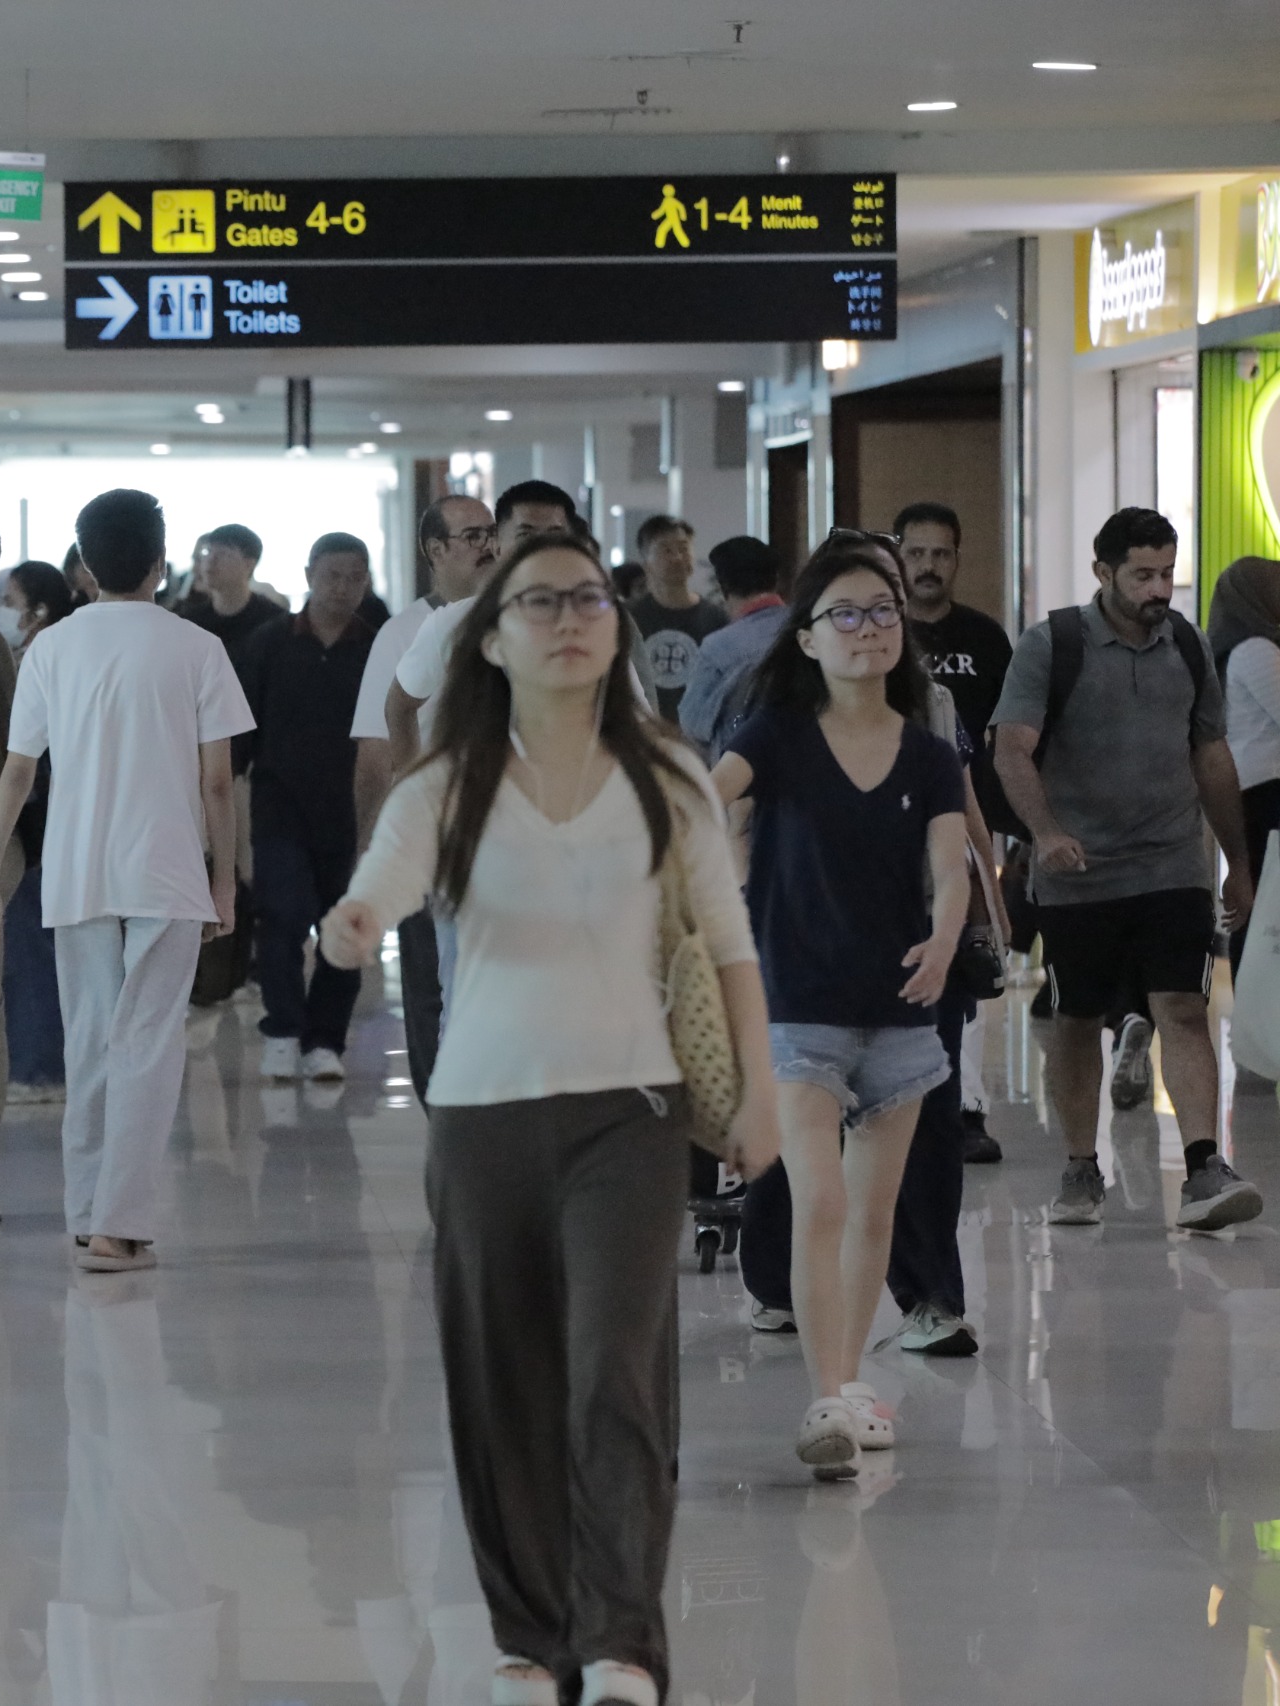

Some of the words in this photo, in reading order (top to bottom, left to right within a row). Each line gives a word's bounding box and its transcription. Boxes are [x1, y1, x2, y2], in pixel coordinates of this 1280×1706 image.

[225, 189, 287, 212] Pintu
[761, 195, 803, 212] Menit
[305, 201, 367, 235] 4-6
[693, 196, 753, 231] 1-4
[761, 213, 820, 230] Minutes
[225, 223, 299, 248] Gates
[223, 279, 288, 304] Toilet
[223, 311, 302, 335] Toilets
